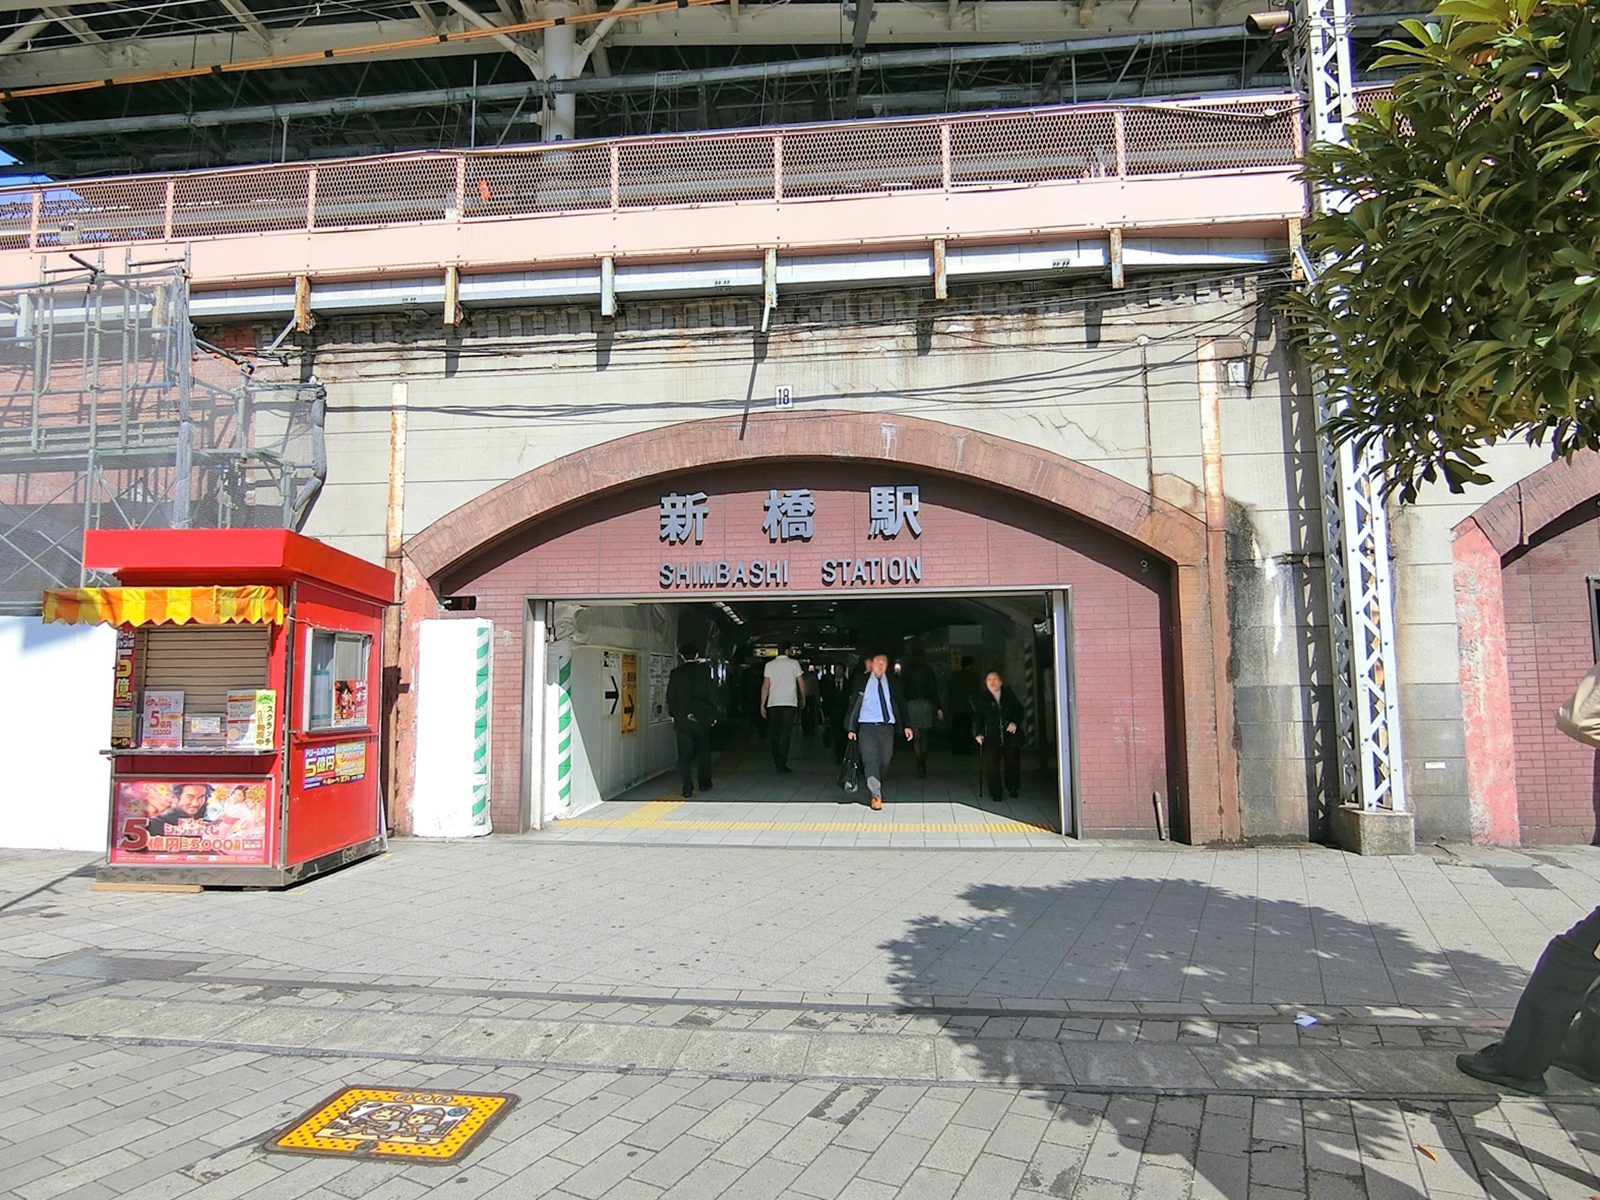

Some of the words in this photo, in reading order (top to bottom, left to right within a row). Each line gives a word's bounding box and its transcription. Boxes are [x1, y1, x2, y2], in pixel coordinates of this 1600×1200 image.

[778, 388, 790, 405] 18
[659, 485, 923, 545] 新橋駅
[659, 560, 790, 588] SHIMBASHI
[821, 556, 922, 586] STATION
[265, 705, 274, 746] スクラッチ
